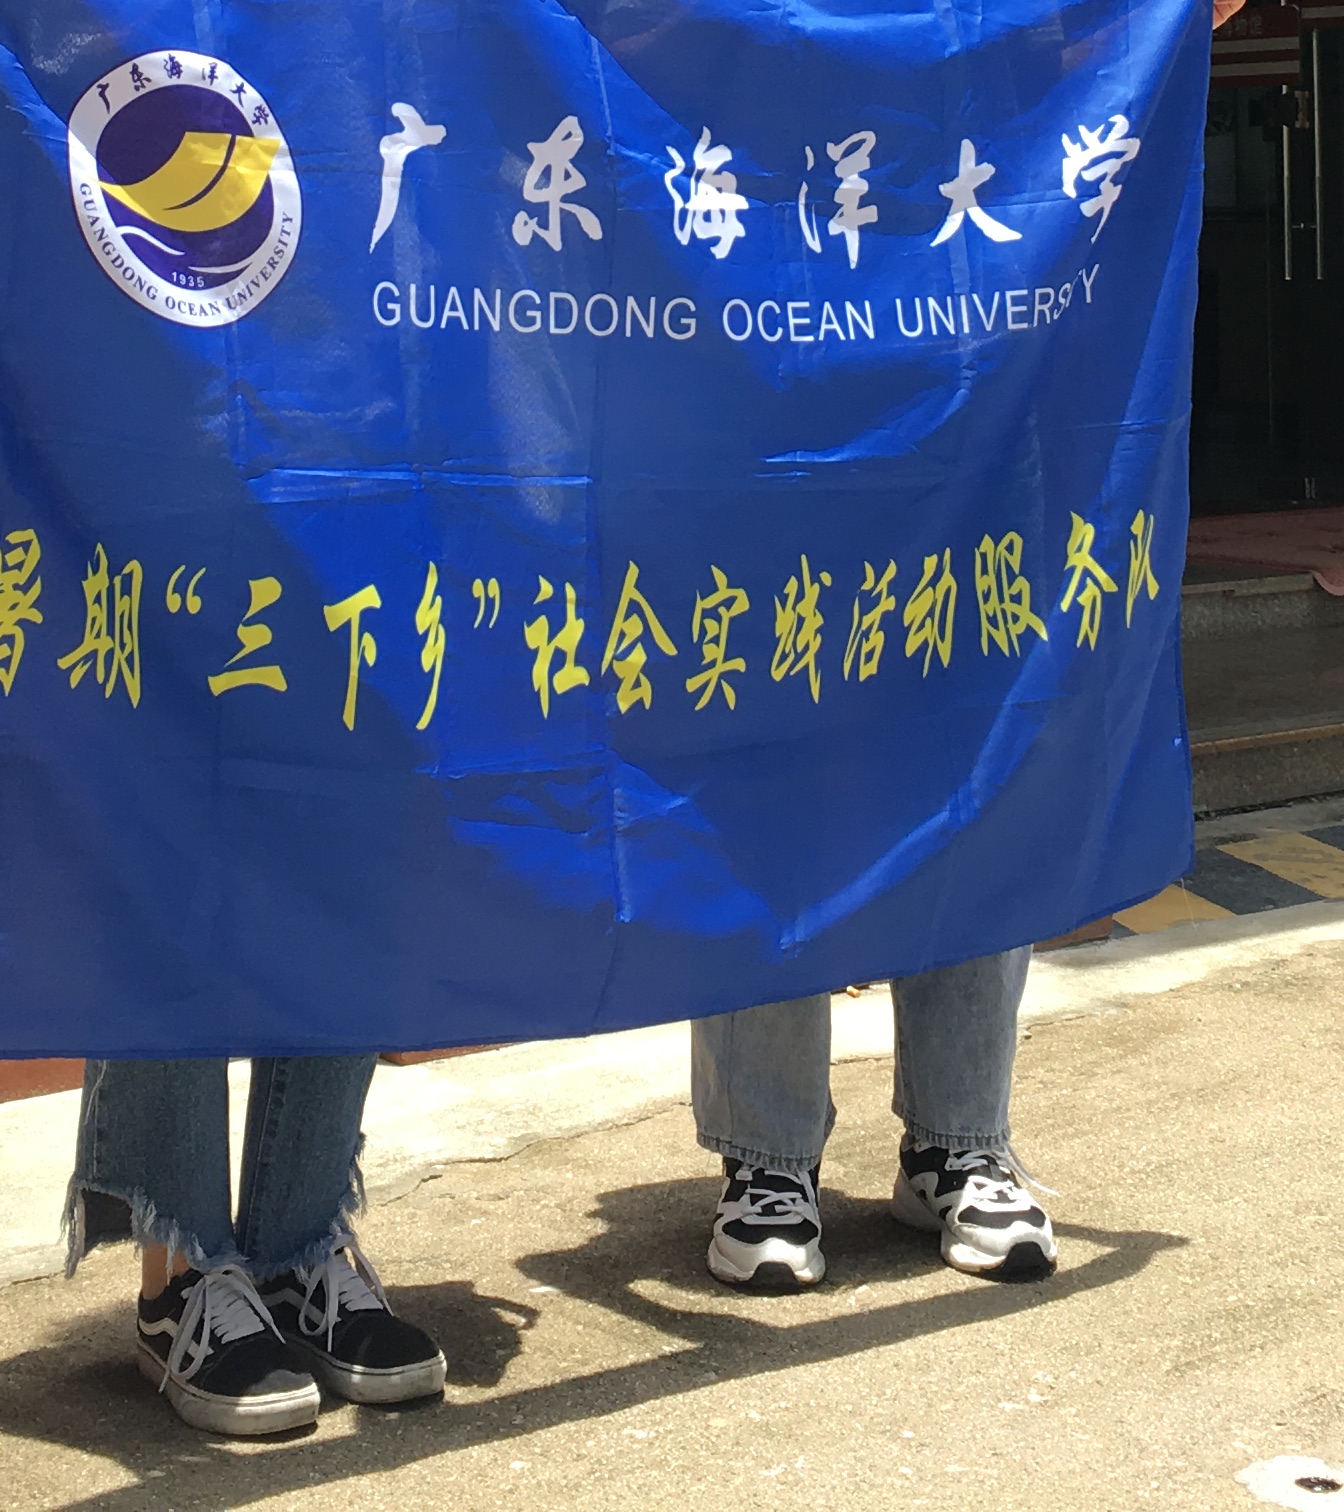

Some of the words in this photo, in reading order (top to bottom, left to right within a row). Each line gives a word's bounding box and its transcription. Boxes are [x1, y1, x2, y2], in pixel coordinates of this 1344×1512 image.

[96, 53, 271, 125] 广东海洋大学
[369, 102, 1141, 269] 广东海洋大学
[80, 182, 159, 301] GUANGDONG
[165, 295, 222, 317] OCEAN
[225, 211, 294, 311] UNIVERSITY
[171, 271, 205, 288] 1935
[371, 281, 698, 341] GUANGDONG
[722, 296, 875, 343] OCEAN
